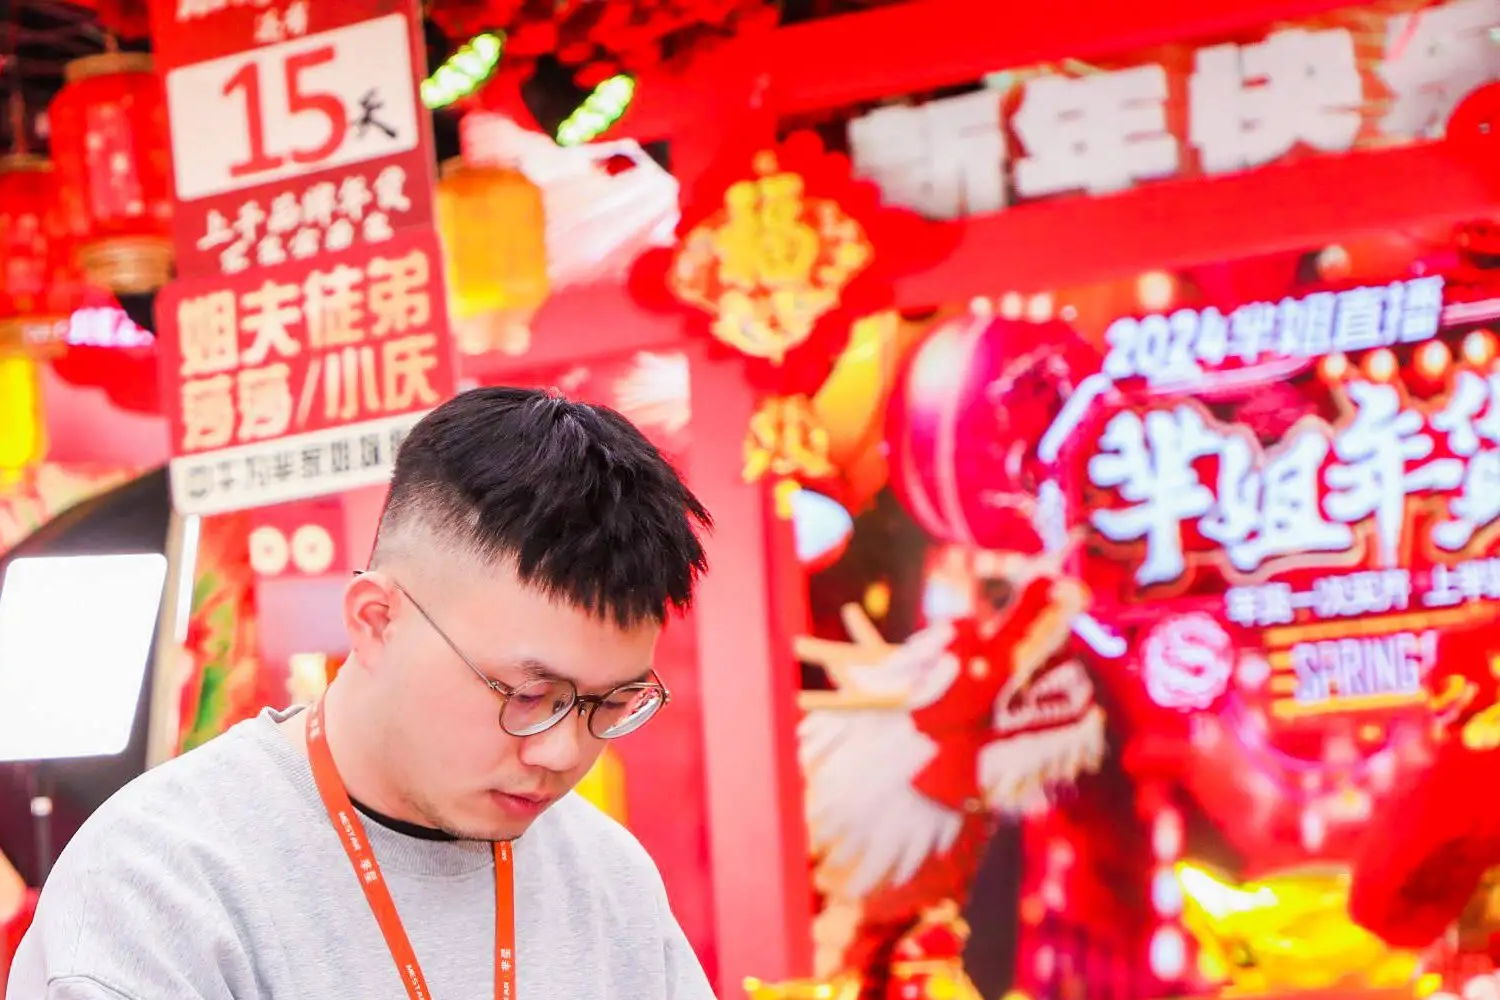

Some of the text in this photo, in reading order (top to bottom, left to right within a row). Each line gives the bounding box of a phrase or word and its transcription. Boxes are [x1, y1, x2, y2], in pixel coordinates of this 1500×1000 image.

[222, 45, 348, 178] 15
[176, 249, 432, 376] 姐夫徒弟
